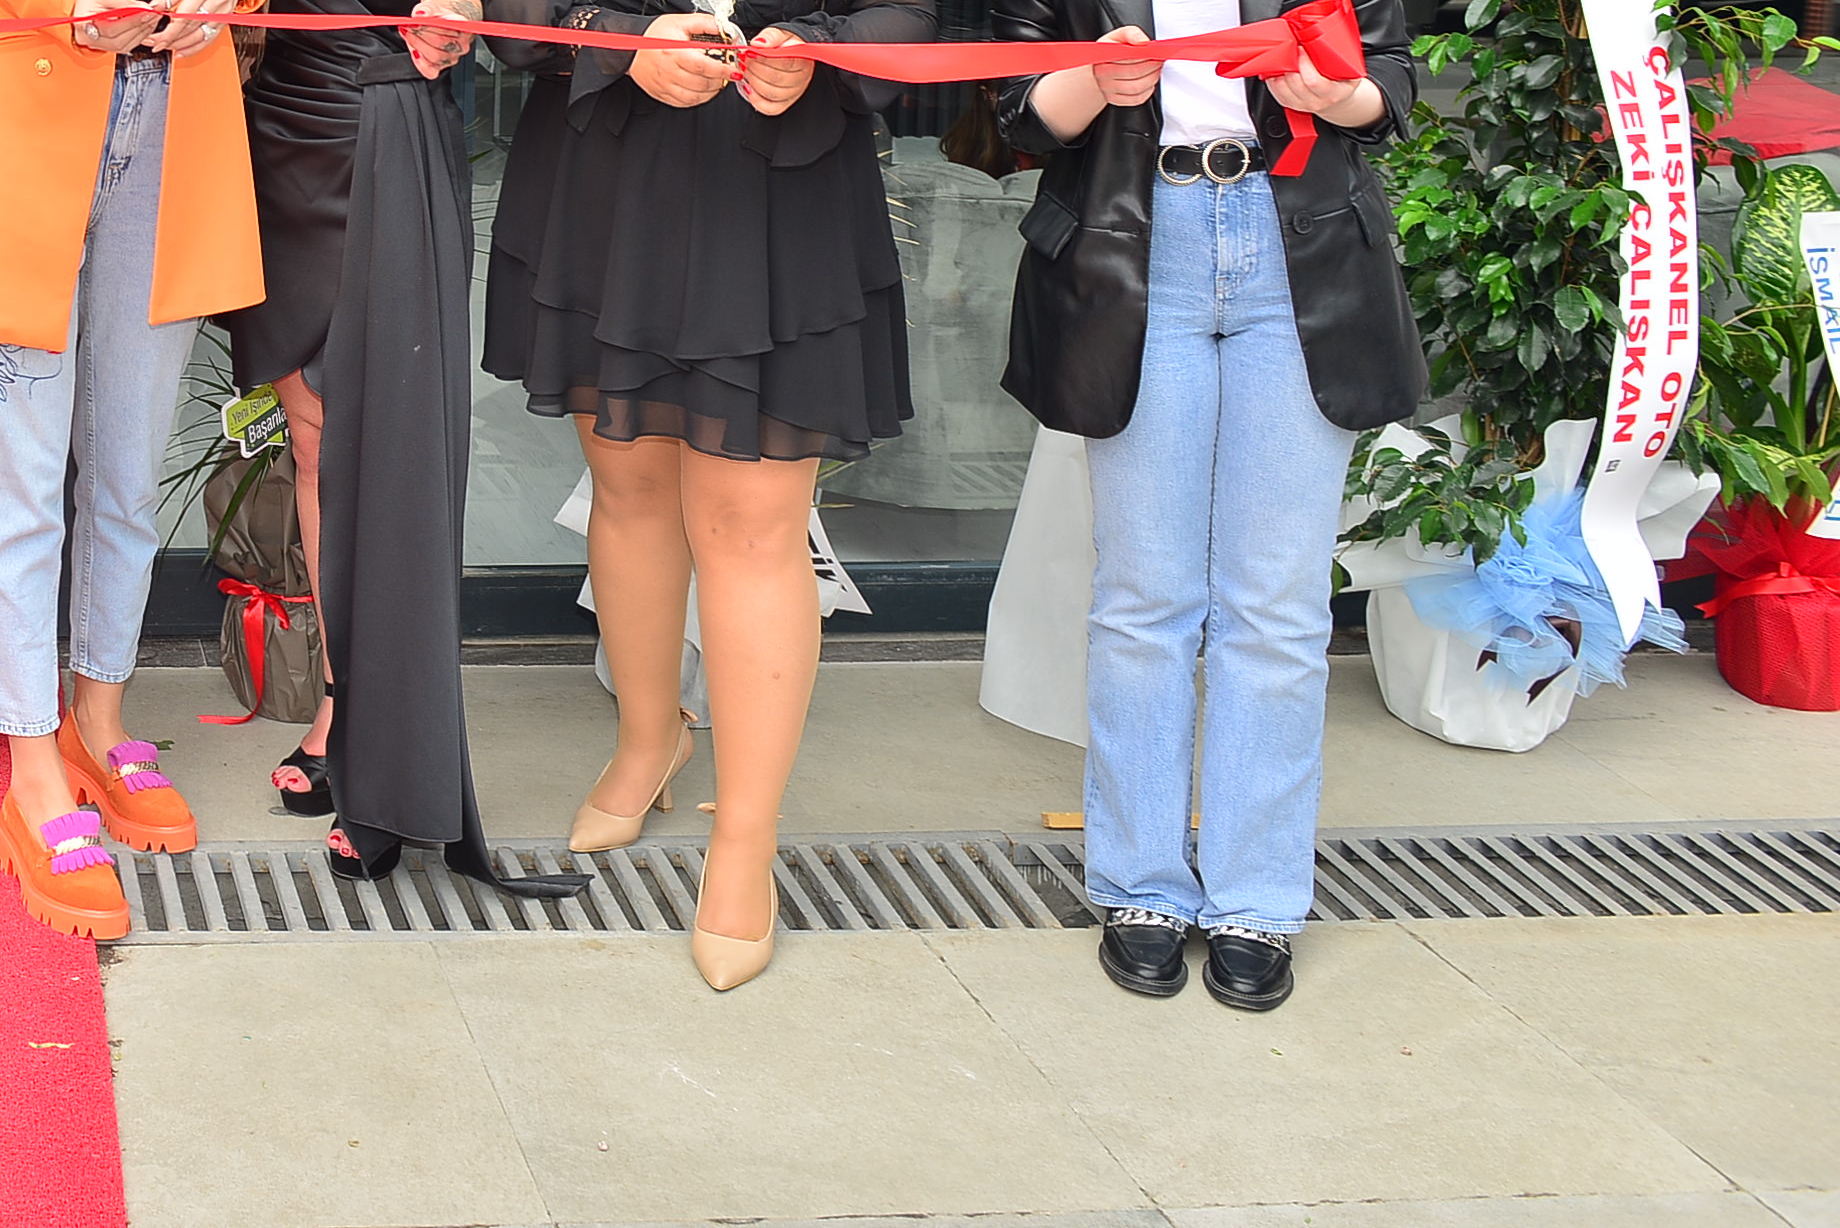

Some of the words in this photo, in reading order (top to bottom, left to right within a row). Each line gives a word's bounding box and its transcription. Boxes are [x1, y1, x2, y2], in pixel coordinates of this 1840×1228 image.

[1610, 70, 1654, 181] ZEKİ
[1642, 46, 1688, 355] ÇALIŞKANEL
[1644, 371, 1682, 457] OTO
